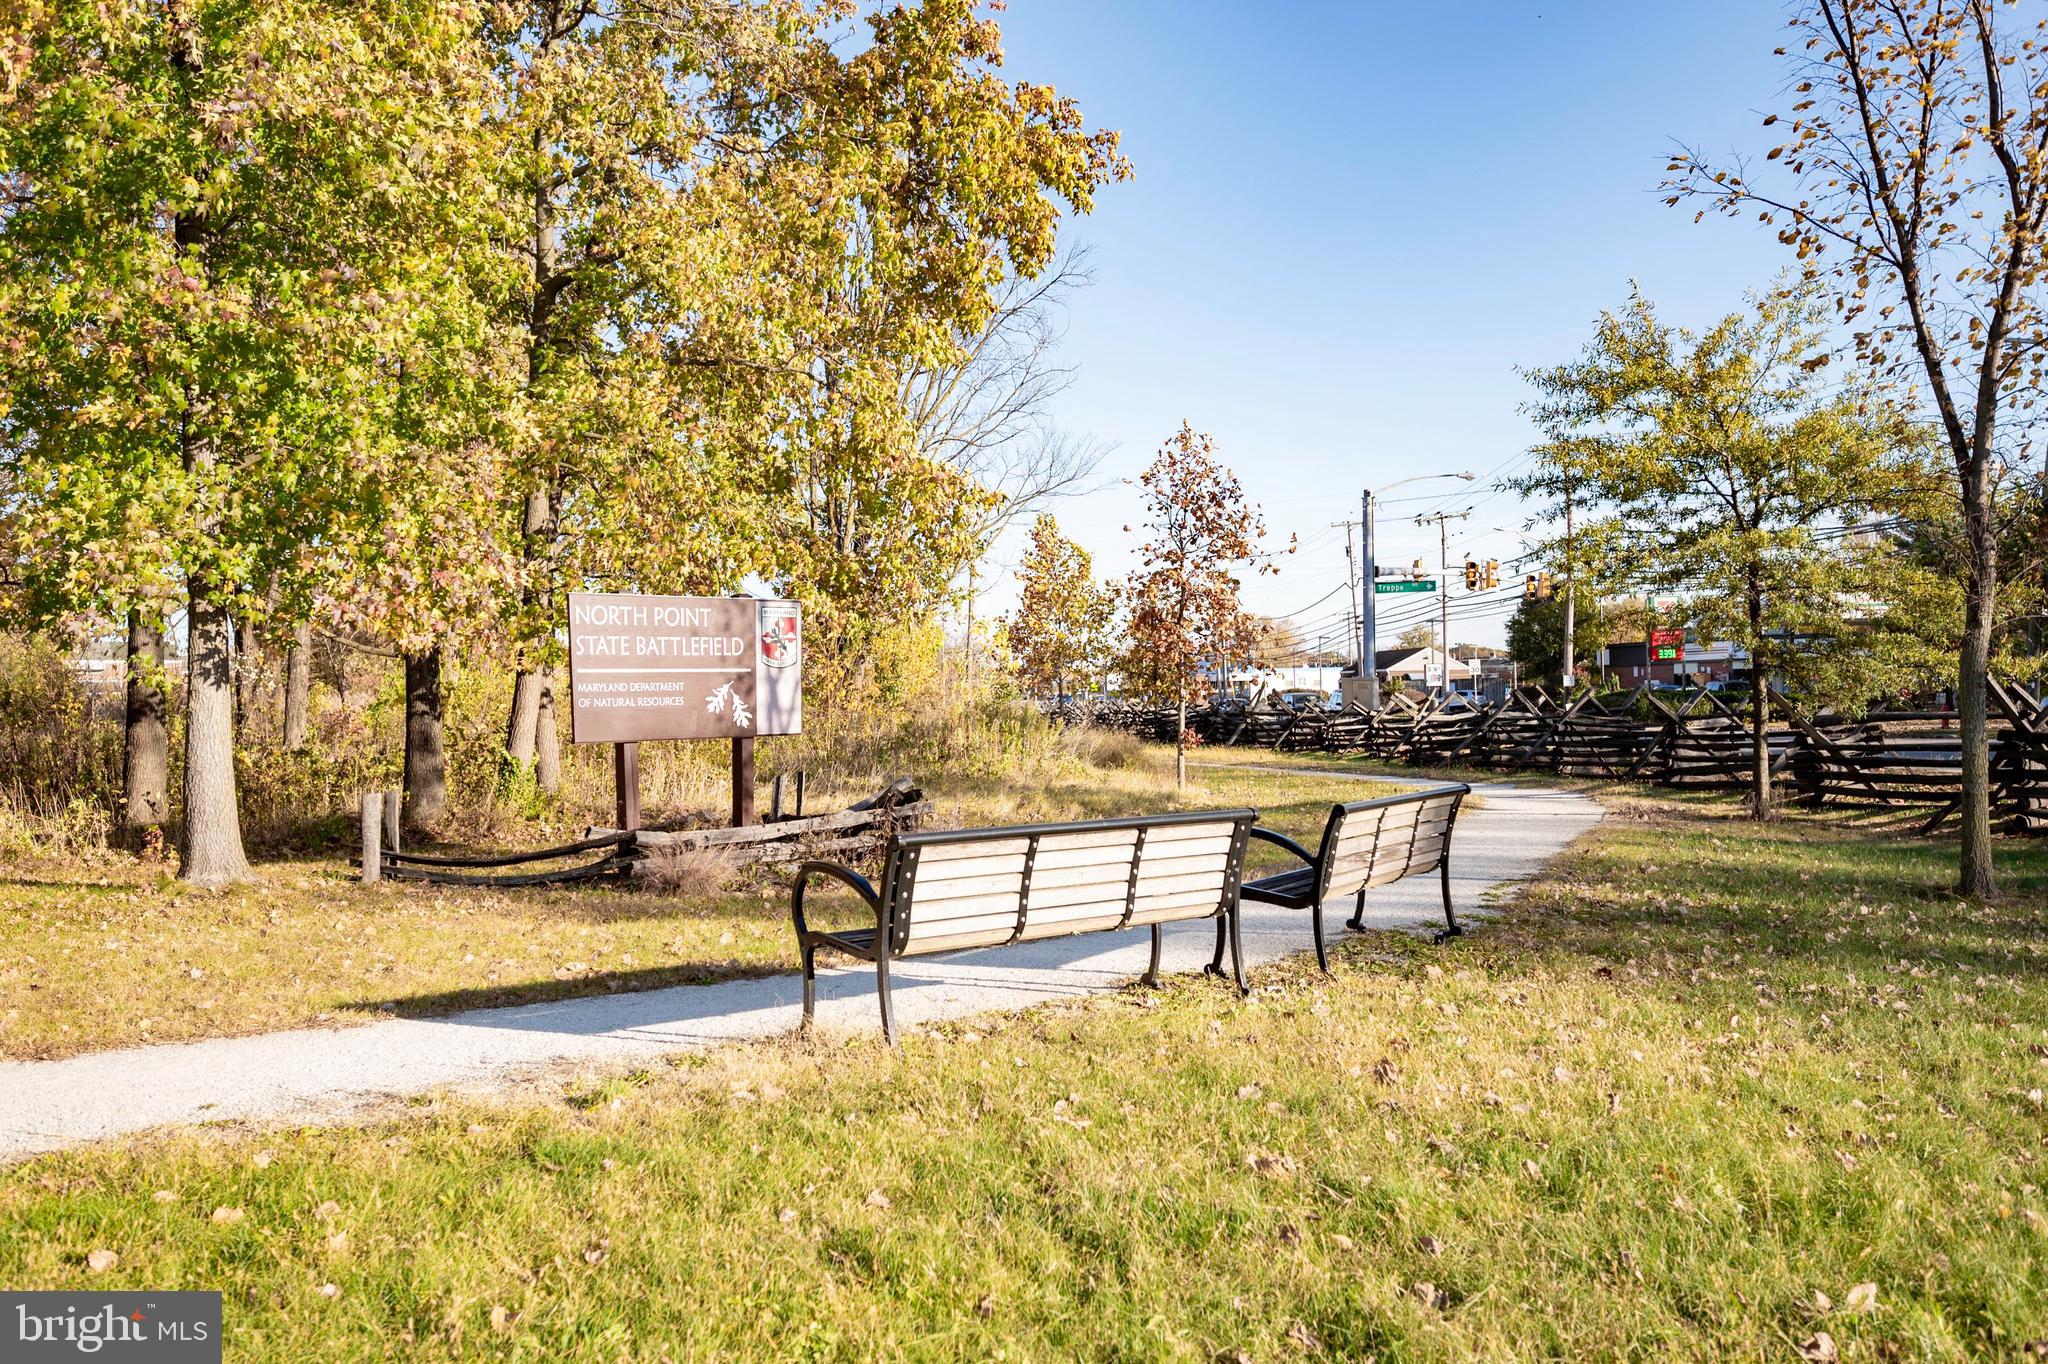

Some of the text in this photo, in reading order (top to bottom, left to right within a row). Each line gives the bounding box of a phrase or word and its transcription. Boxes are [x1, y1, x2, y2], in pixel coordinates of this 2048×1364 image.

[1378, 584, 1404, 592] Trappe
[575, 605, 711, 627] NORTH POINT
[575, 635, 744, 656] STATE BATTLEFIELD
[577, 682, 685, 692] MARYLAND DEPARTMENT
[578, 697, 684, 708] OF NATURAL RESOURCES
